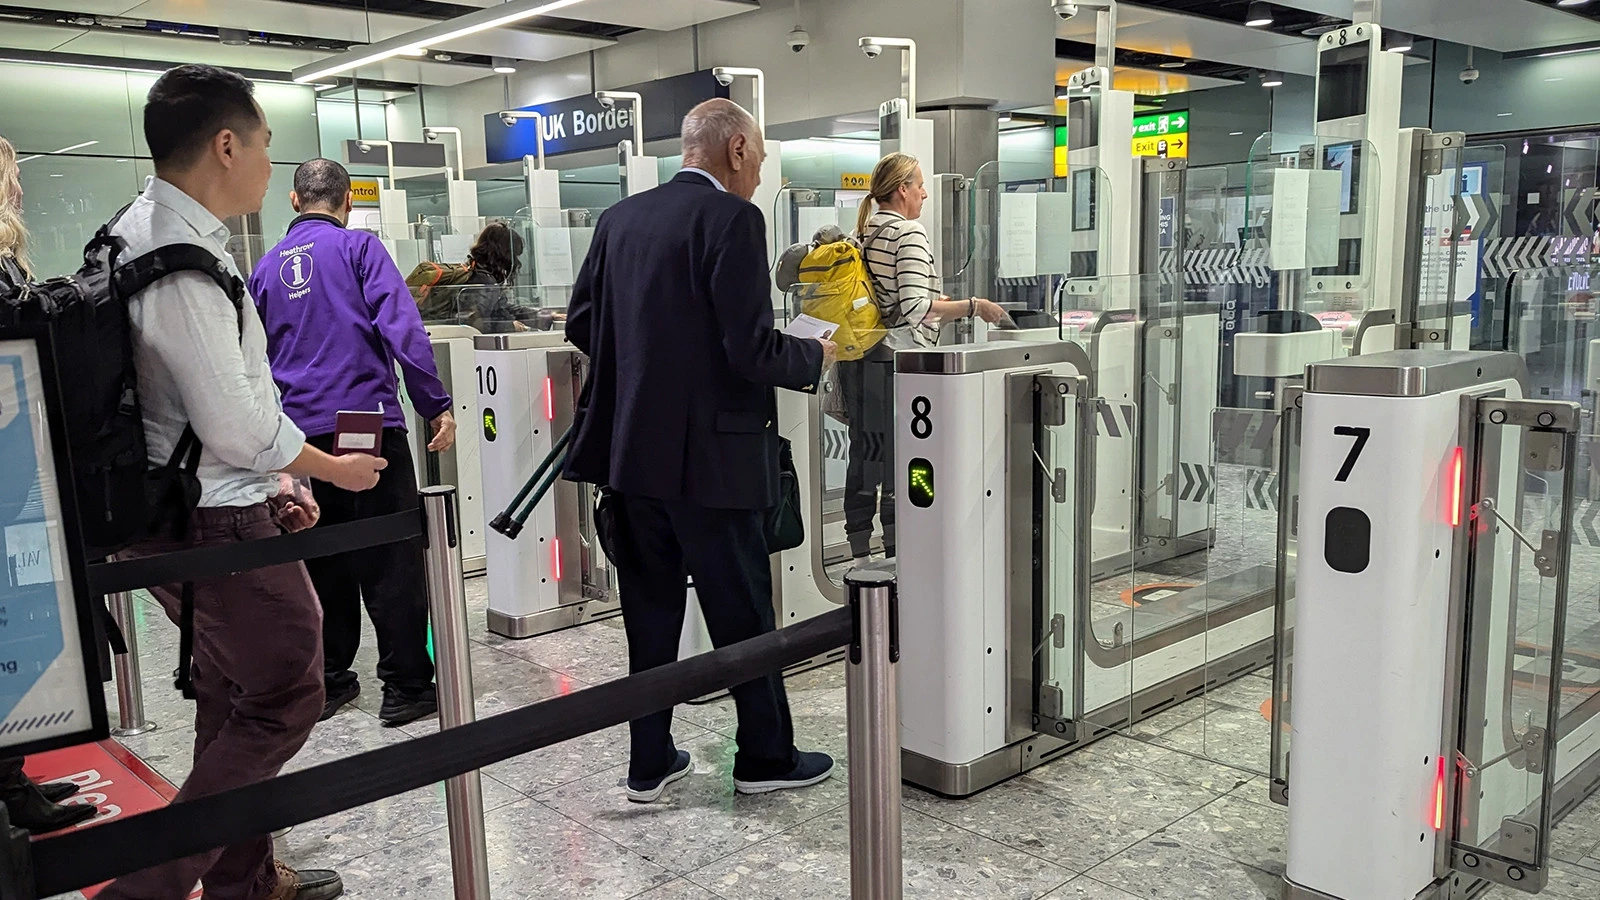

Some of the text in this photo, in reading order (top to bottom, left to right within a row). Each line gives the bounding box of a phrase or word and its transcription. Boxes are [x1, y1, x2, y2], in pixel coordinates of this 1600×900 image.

[1339, 29, 1346, 45] 8
[1081, 72, 1086, 85] 9
[542, 113, 566, 141] UK
[1138, 122, 1156, 132] exit
[1136, 141, 1155, 152] Exit
[350, 187, 377, 196] ntrol
[279, 242, 315, 257] Heathrow
[288, 287, 311, 300] Helpers
[476, 365, 497, 396] 10
[910, 396, 933, 439] 8
[1334, 425, 1370, 482] 7
